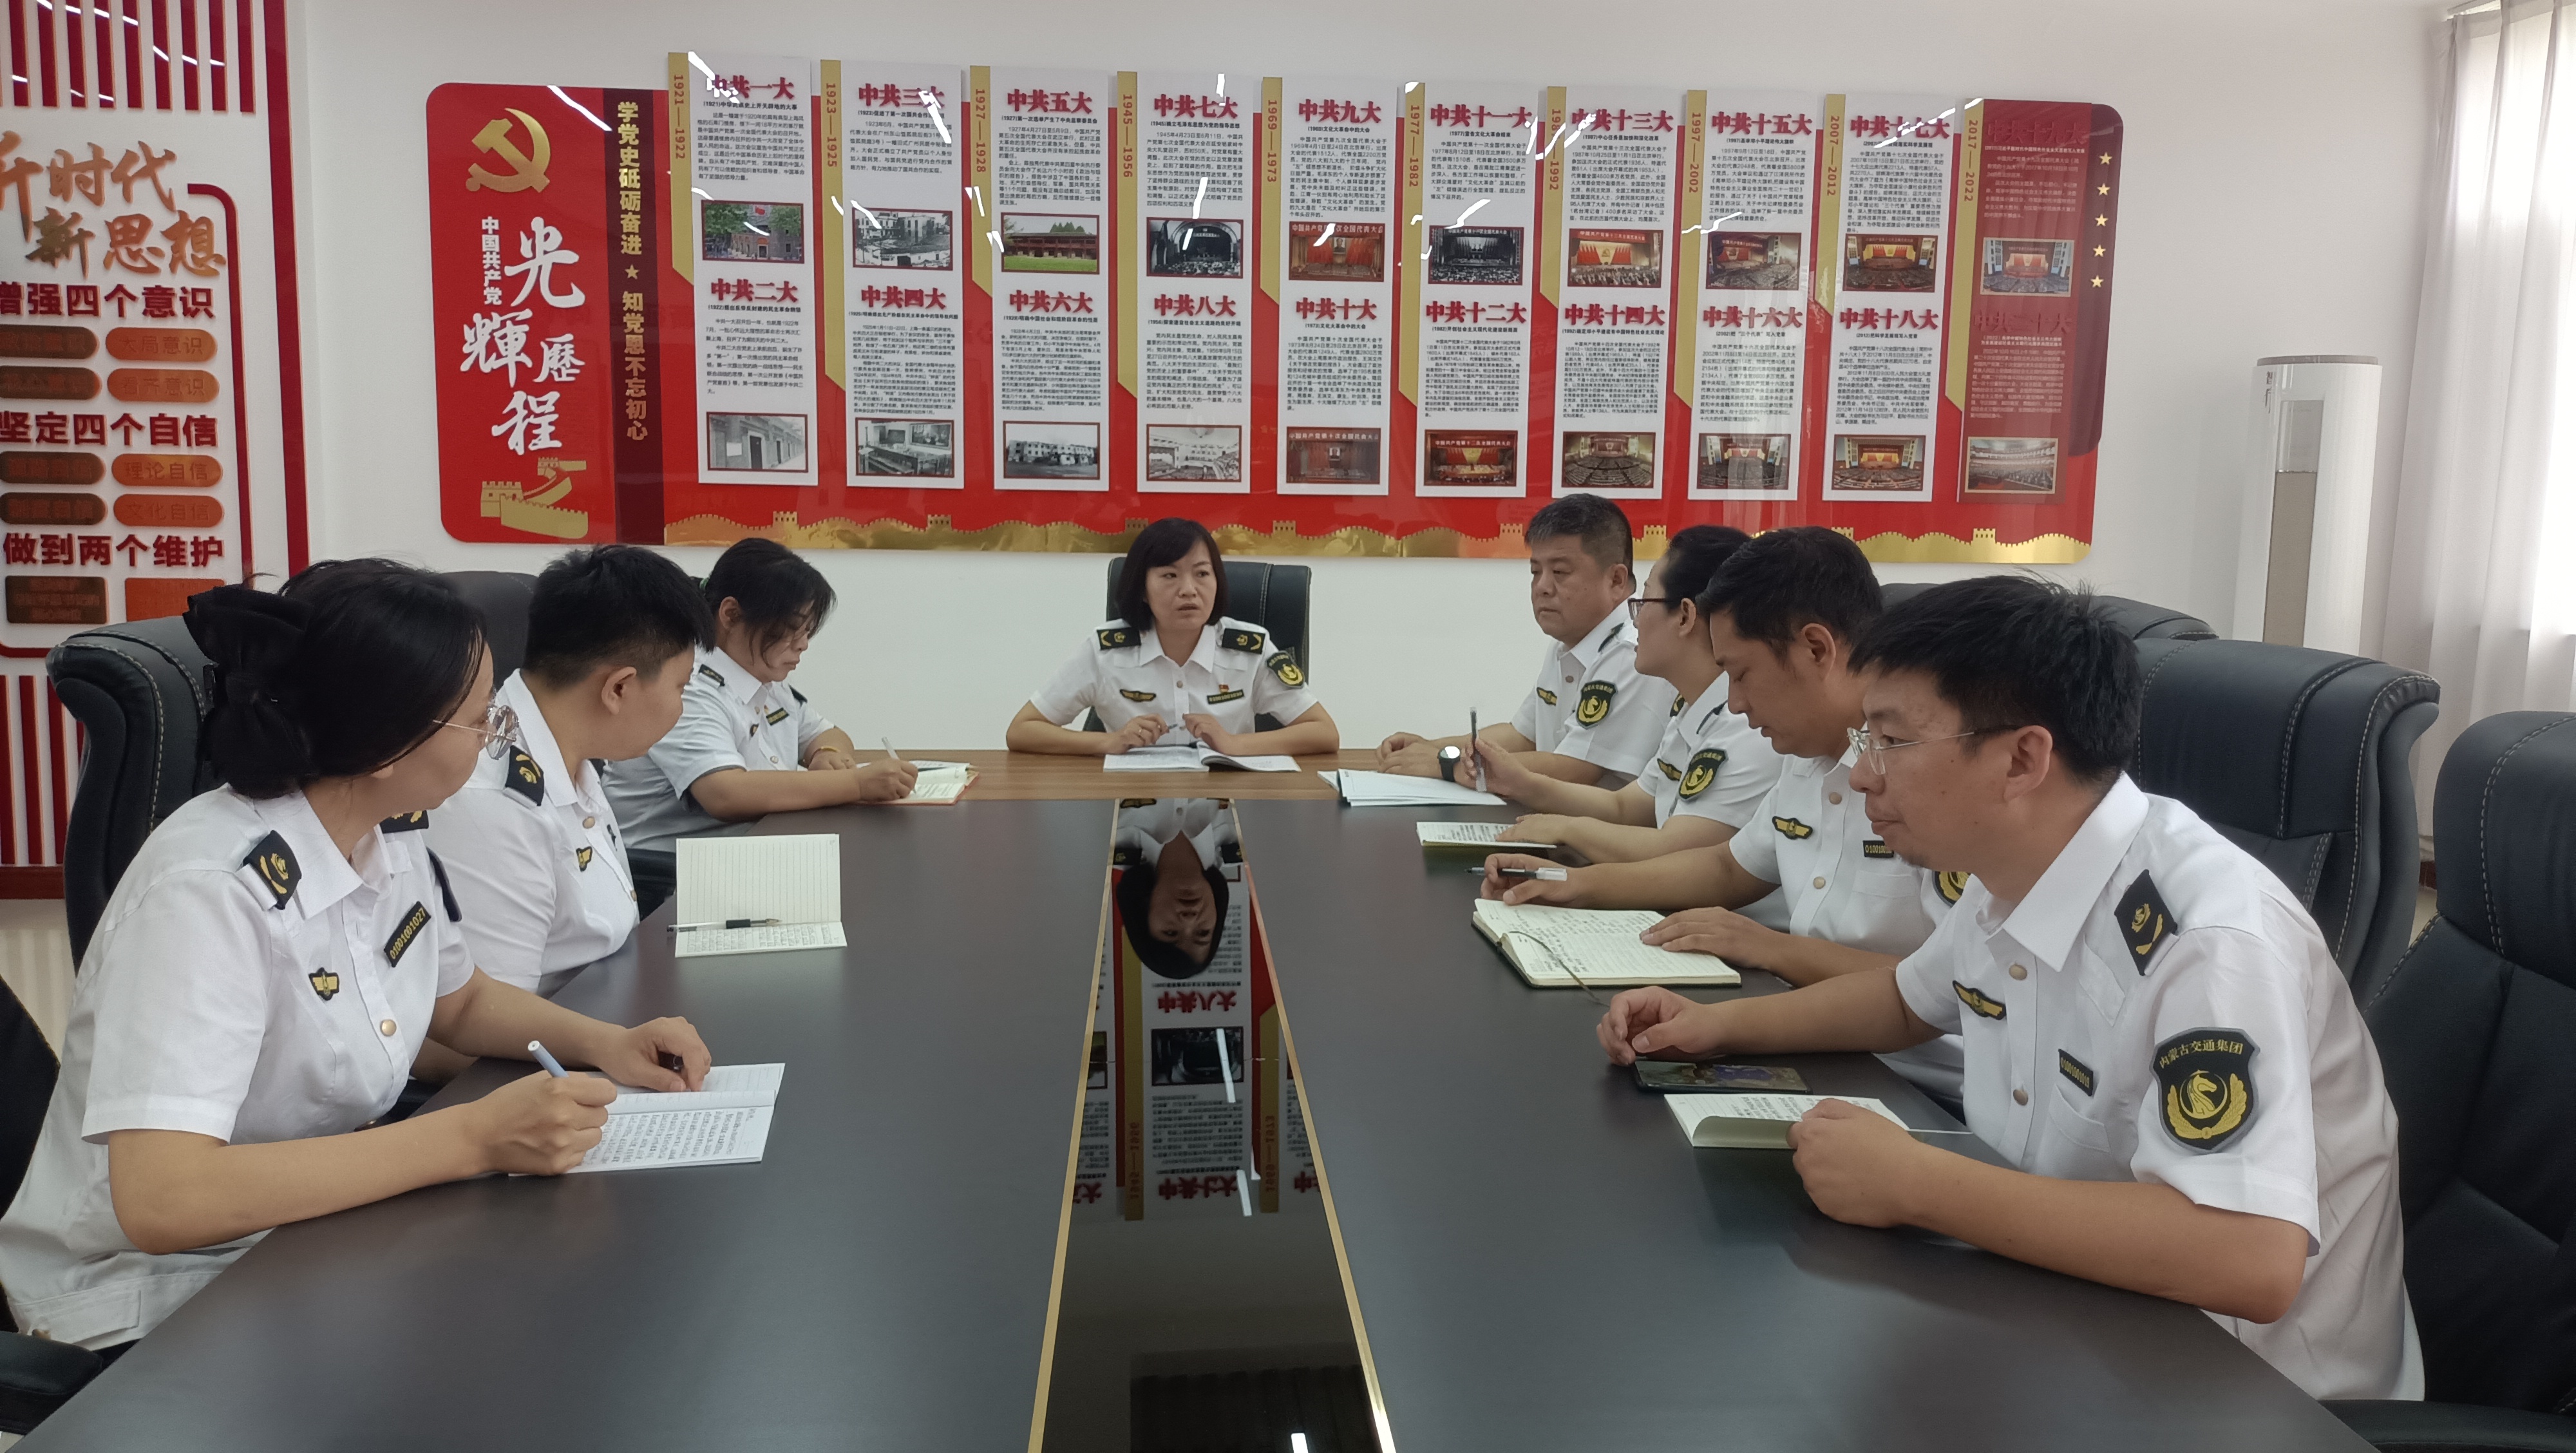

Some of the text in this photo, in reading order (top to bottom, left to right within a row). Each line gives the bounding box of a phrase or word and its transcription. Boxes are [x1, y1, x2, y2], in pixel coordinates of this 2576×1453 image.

[1007, 89, 1092, 113] 中共五大
[1153, 94, 1237, 118] 中共七大
[1298, 99, 1381, 123] 中共九大
[1430, 104, 1531, 127] 中共十一大
[1711, 111, 1812, 135] 中共十五大
[1987, 120, 2087, 145] 中共十九大
[617, 101, 643, 255] 学党史砥砺奋进
[24, 206, 226, 280] 新思想
[481, 216, 502, 306] 中国共产党
[710, 278, 798, 302] 中共二大
[861, 285, 945, 309] 中共四大
[1009, 290, 1092, 312] 中共六大
[1153, 294, 1235, 316] 中共八大
[1296, 298, 1376, 319] 中共十大
[1425, 300, 1526, 323] 中共十二大
[1564, 303, 1665, 325] 中共十四大
[1703, 305, 1801, 327] 中共十六大
[1839, 307, 1938, 329] 中共十八大
[118, 336, 203, 355] 大局意识
[622, 290, 649, 441] 知党恩不忘初心
[121, 377, 205, 396] 看齐意识
[0, 410, 218, 447] 坚定四个自信
[125, 462, 208, 480] 理论自信
[128, 502, 210, 521] 文化自信
[3, 533, 224, 568] 做到两个维护
[390, 907, 426, 960] 01001001027
[2159, 1039, 2244, 1069] 内蒙古交通集团
